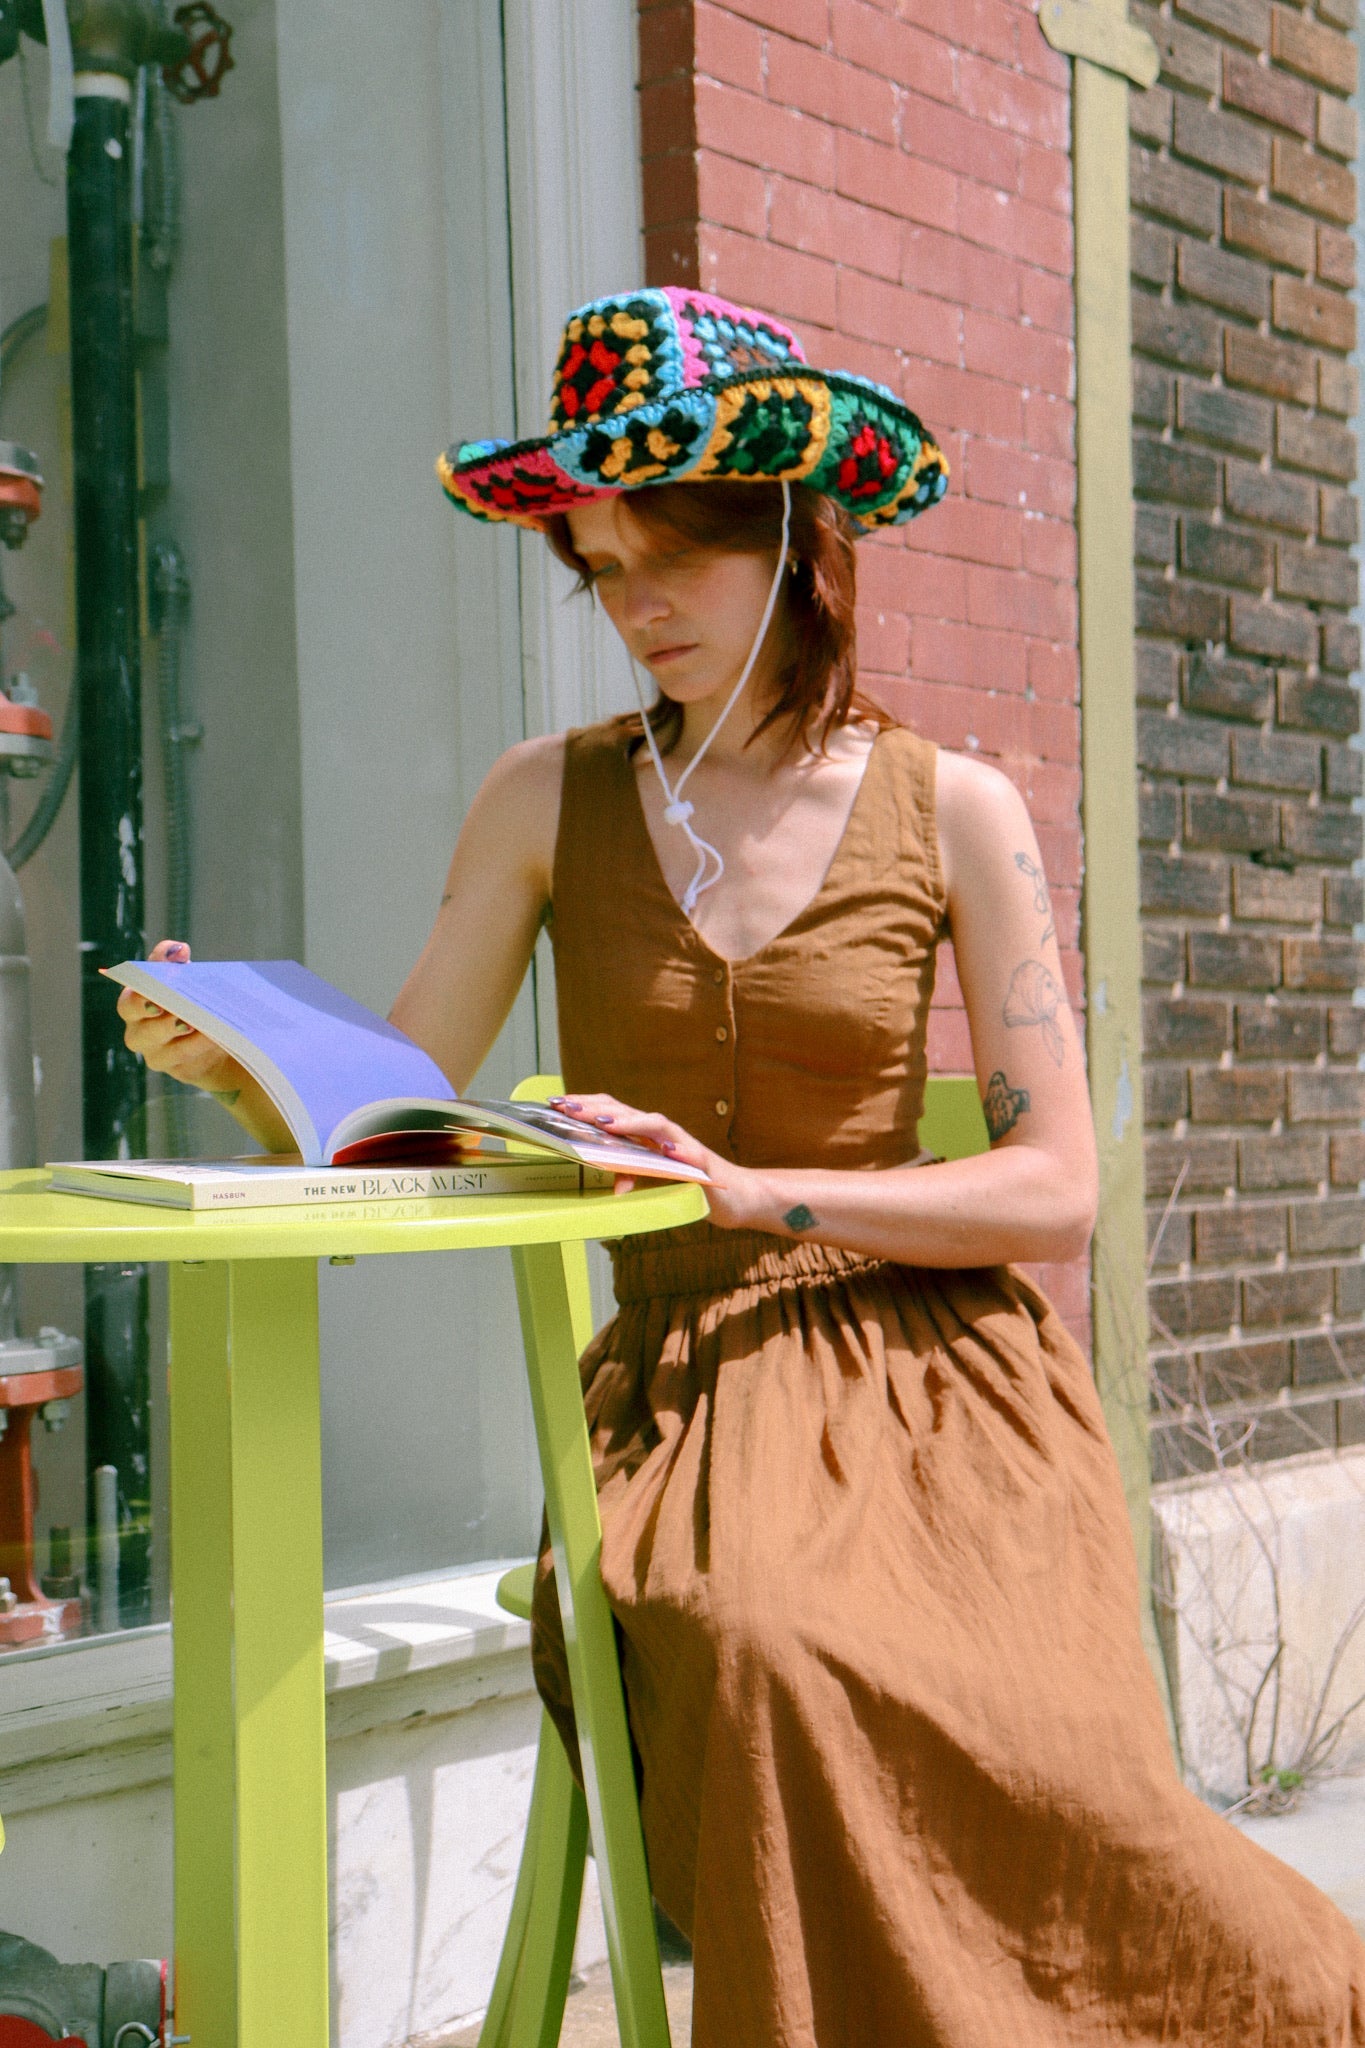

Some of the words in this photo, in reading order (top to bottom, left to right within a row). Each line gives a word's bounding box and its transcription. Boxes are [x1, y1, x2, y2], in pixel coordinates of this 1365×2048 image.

[303, 1186, 326, 1196] THE
[331, 1184, 356, 1194] NEW
[362, 1176, 425, 1195] BLACK
[431, 1173, 488, 1191] WEST
[212, 1192, 246, 1200] HASBUN
